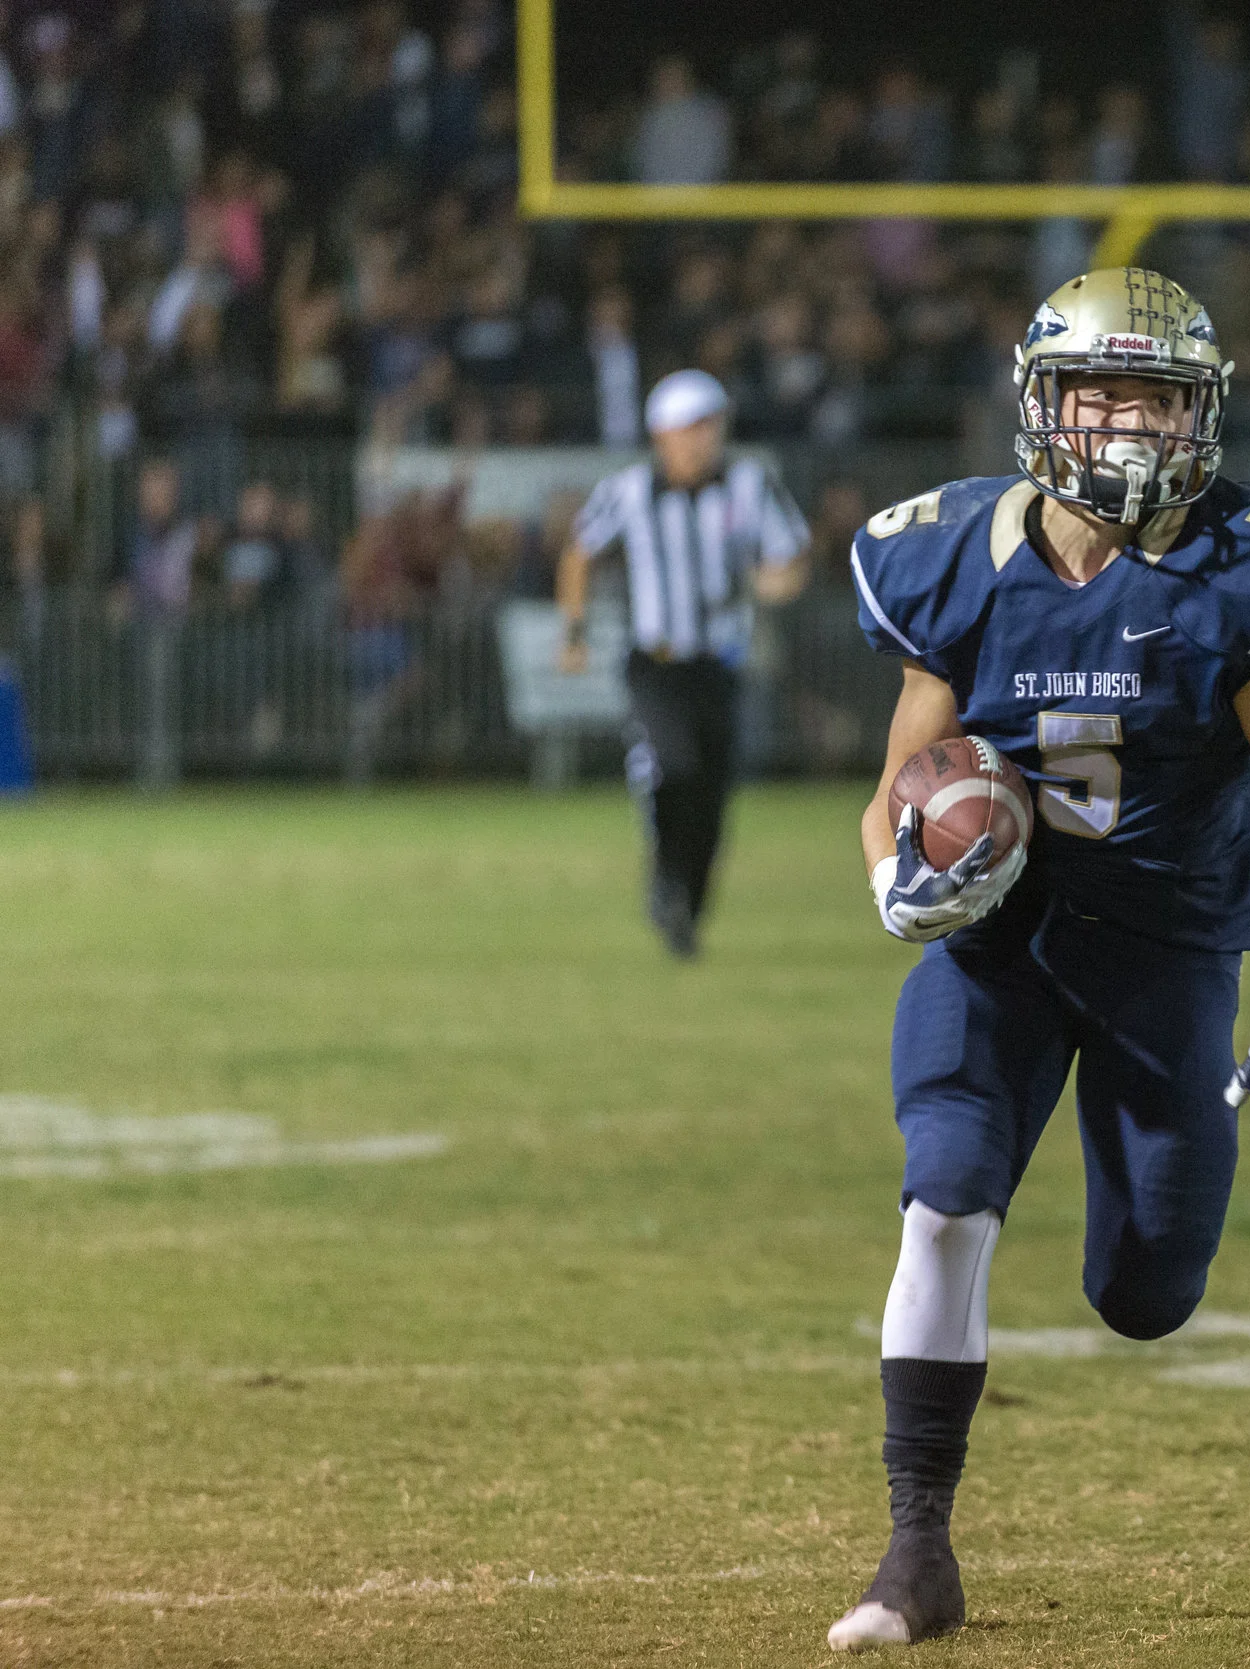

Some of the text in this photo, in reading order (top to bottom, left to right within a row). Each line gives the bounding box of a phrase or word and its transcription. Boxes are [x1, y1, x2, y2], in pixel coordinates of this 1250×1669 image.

[1108, 336, 1153, 351] Riddell
[866, 490, 943, 540] 5
[1014, 671, 1142, 698] ST. JOHN BOSCO
[1038, 711, 1124, 840] 5
